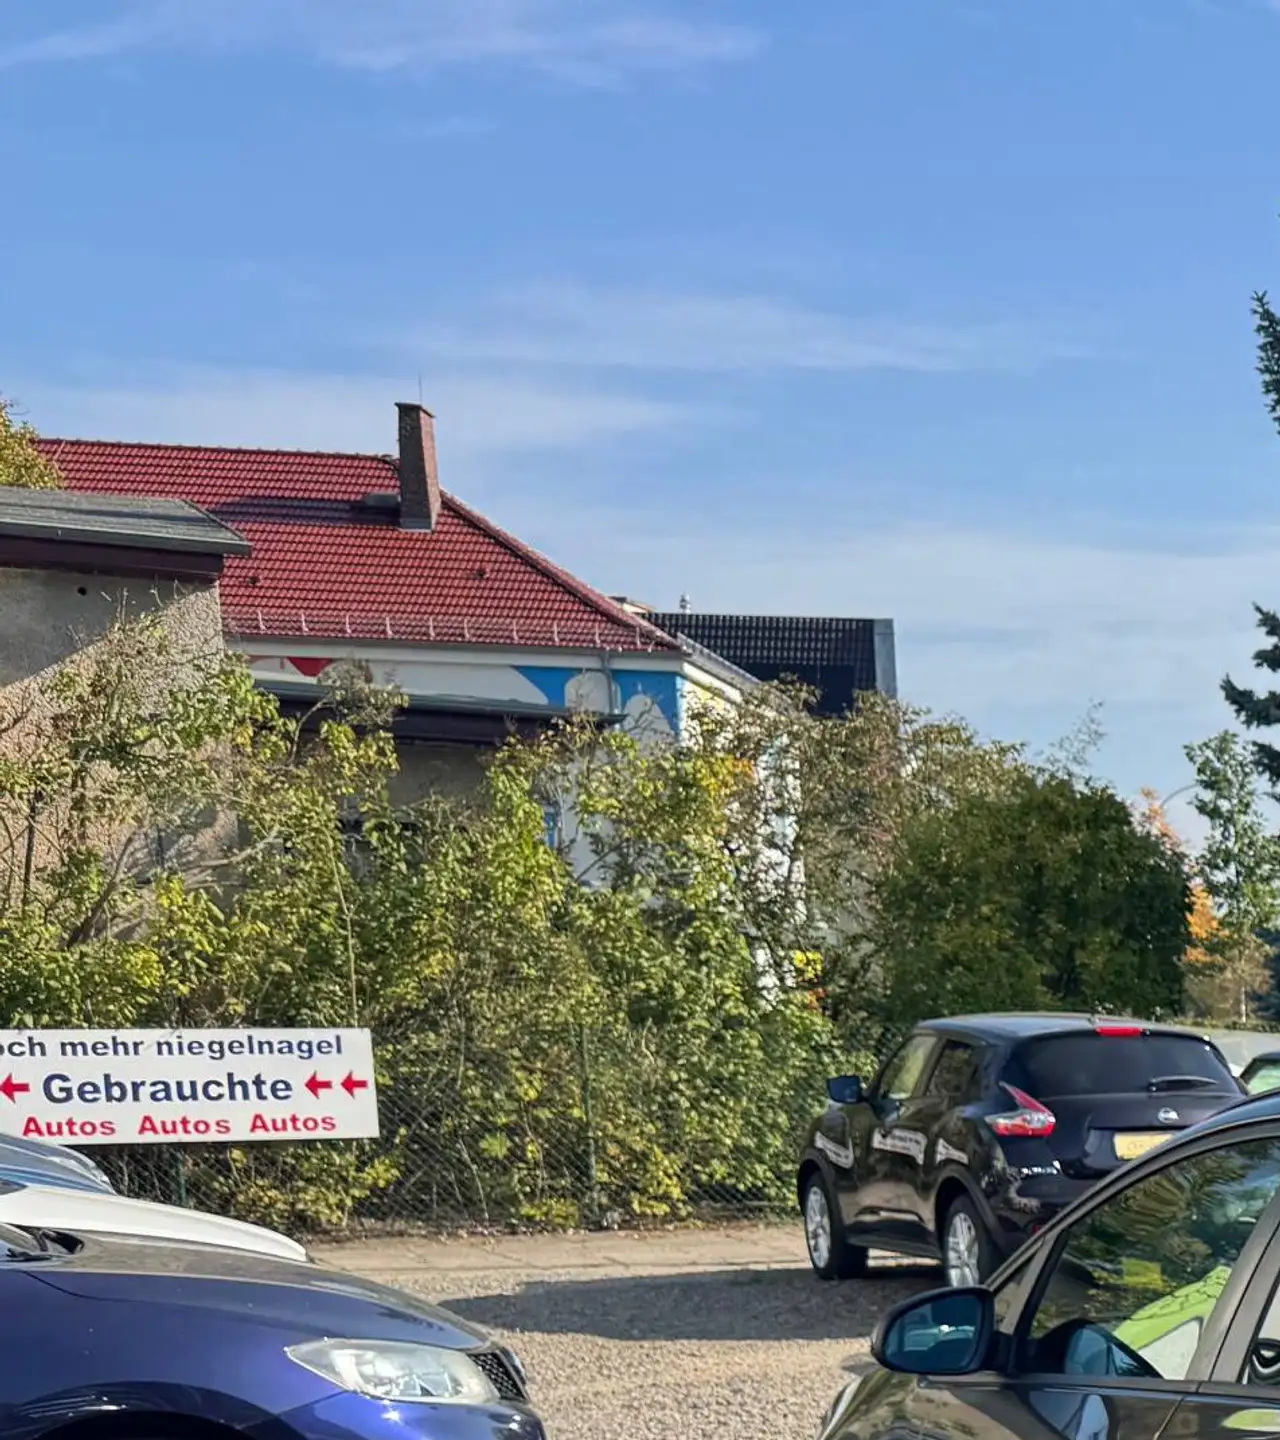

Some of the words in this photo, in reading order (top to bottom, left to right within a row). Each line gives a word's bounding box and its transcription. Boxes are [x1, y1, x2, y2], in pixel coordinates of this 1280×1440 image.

[0, 1036, 47, 1057] ch
[60, 1035, 144, 1057] mehr
[156, 1035, 342, 1060] niegelnagel
[43, 1072, 293, 1104] Gebrauchte
[22, 1116, 116, 1137] Autos
[138, 1115, 231, 1136] Autos
[249, 1113, 337, 1133] Autos
